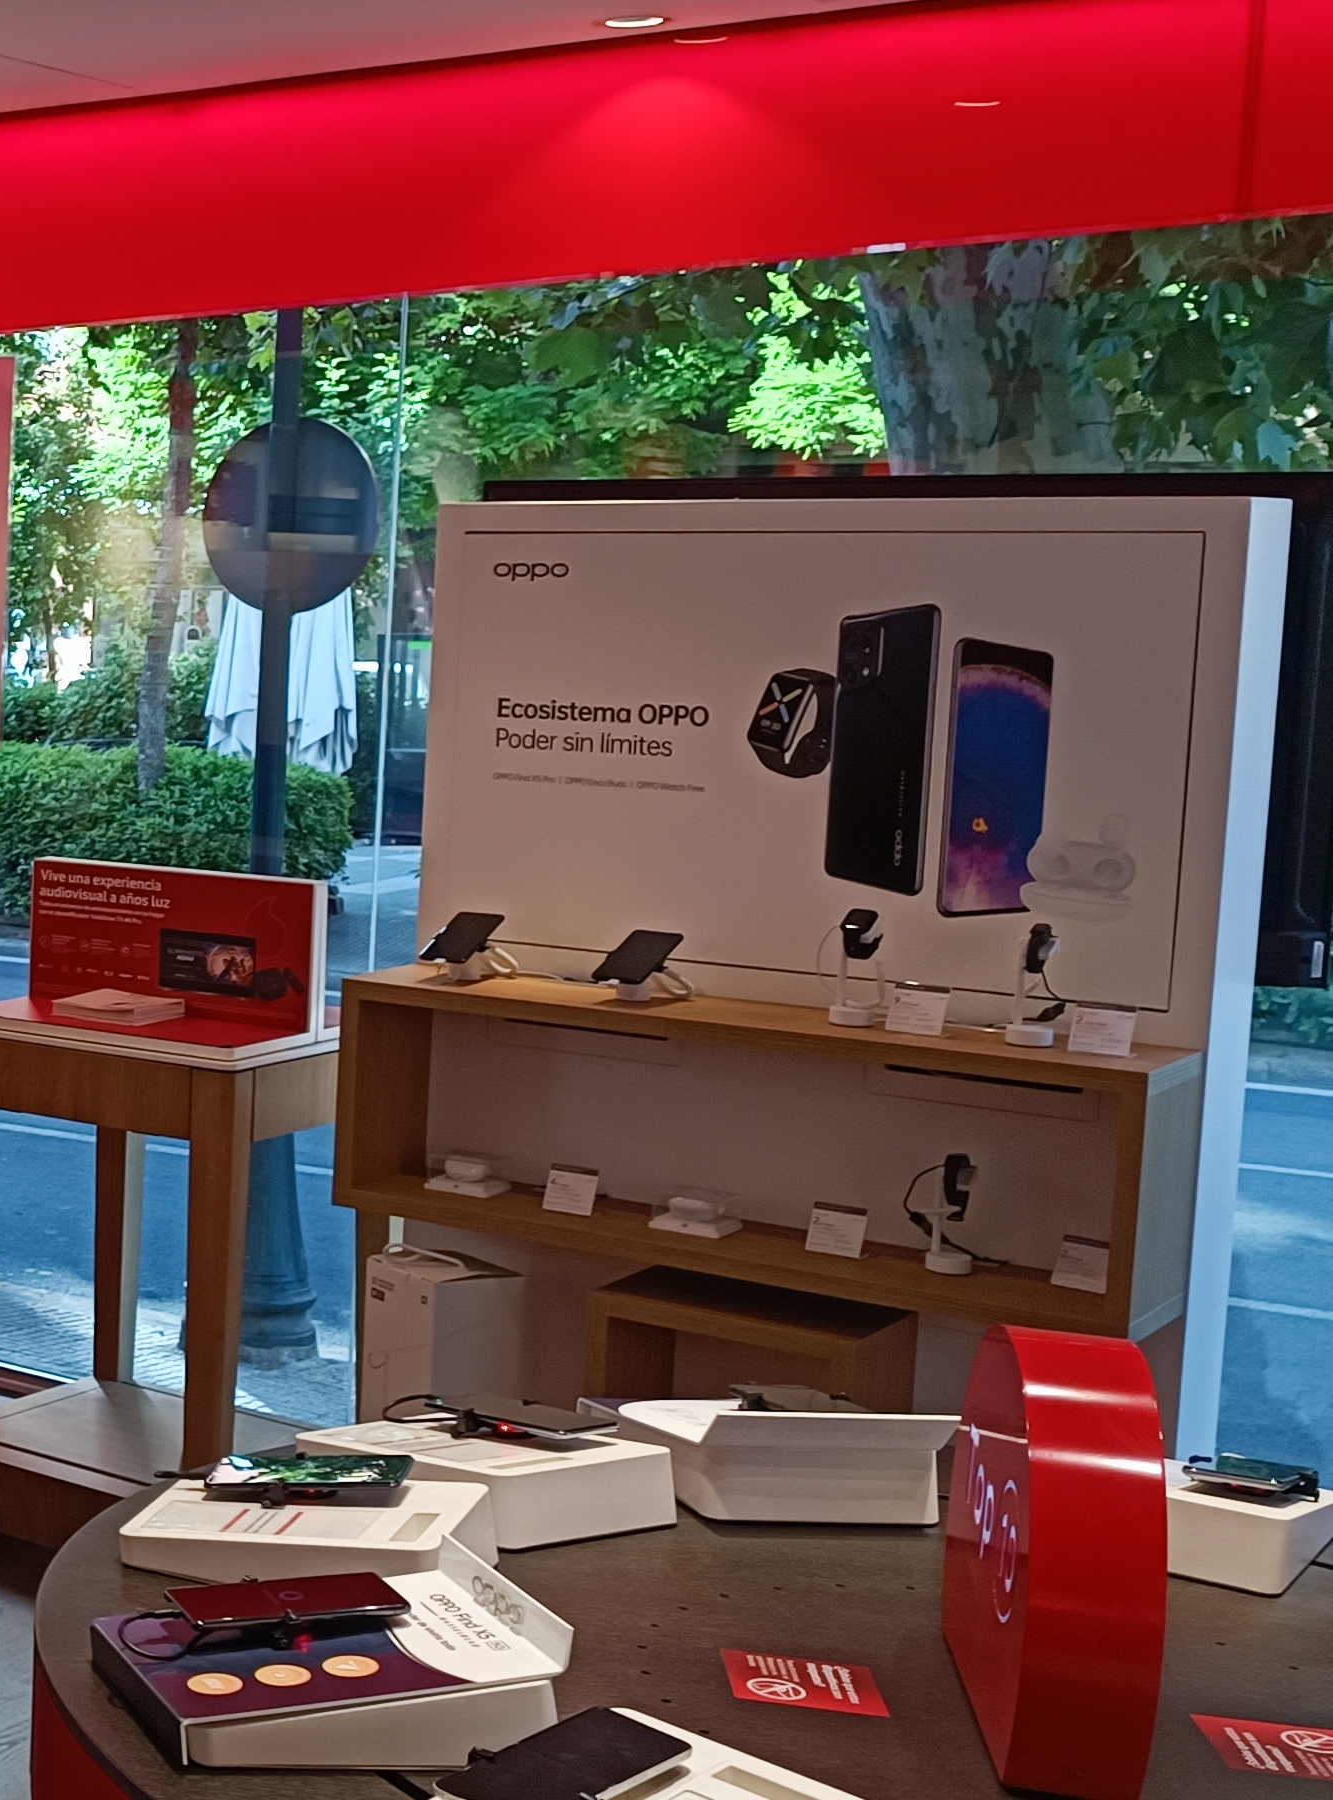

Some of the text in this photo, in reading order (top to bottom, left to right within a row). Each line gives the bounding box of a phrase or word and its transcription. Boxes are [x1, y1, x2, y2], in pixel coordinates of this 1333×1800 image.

[493, 562, 569, 582] oppo
[497, 698, 709, 727] Ecosistema OPPO
[496, 727, 673, 756] Poder sin límites
[40, 869, 162, 891] Vive una experiencia
[39, 886, 107, 902] audiovisual
[109, 894, 117, 903] a
[119, 892, 149, 906] años
[151, 895, 171, 909] luz
[429, 1593, 462, 1613] OPPO
[452, 1609, 478, 1629] Find
[473, 1624, 497, 1640] X5
